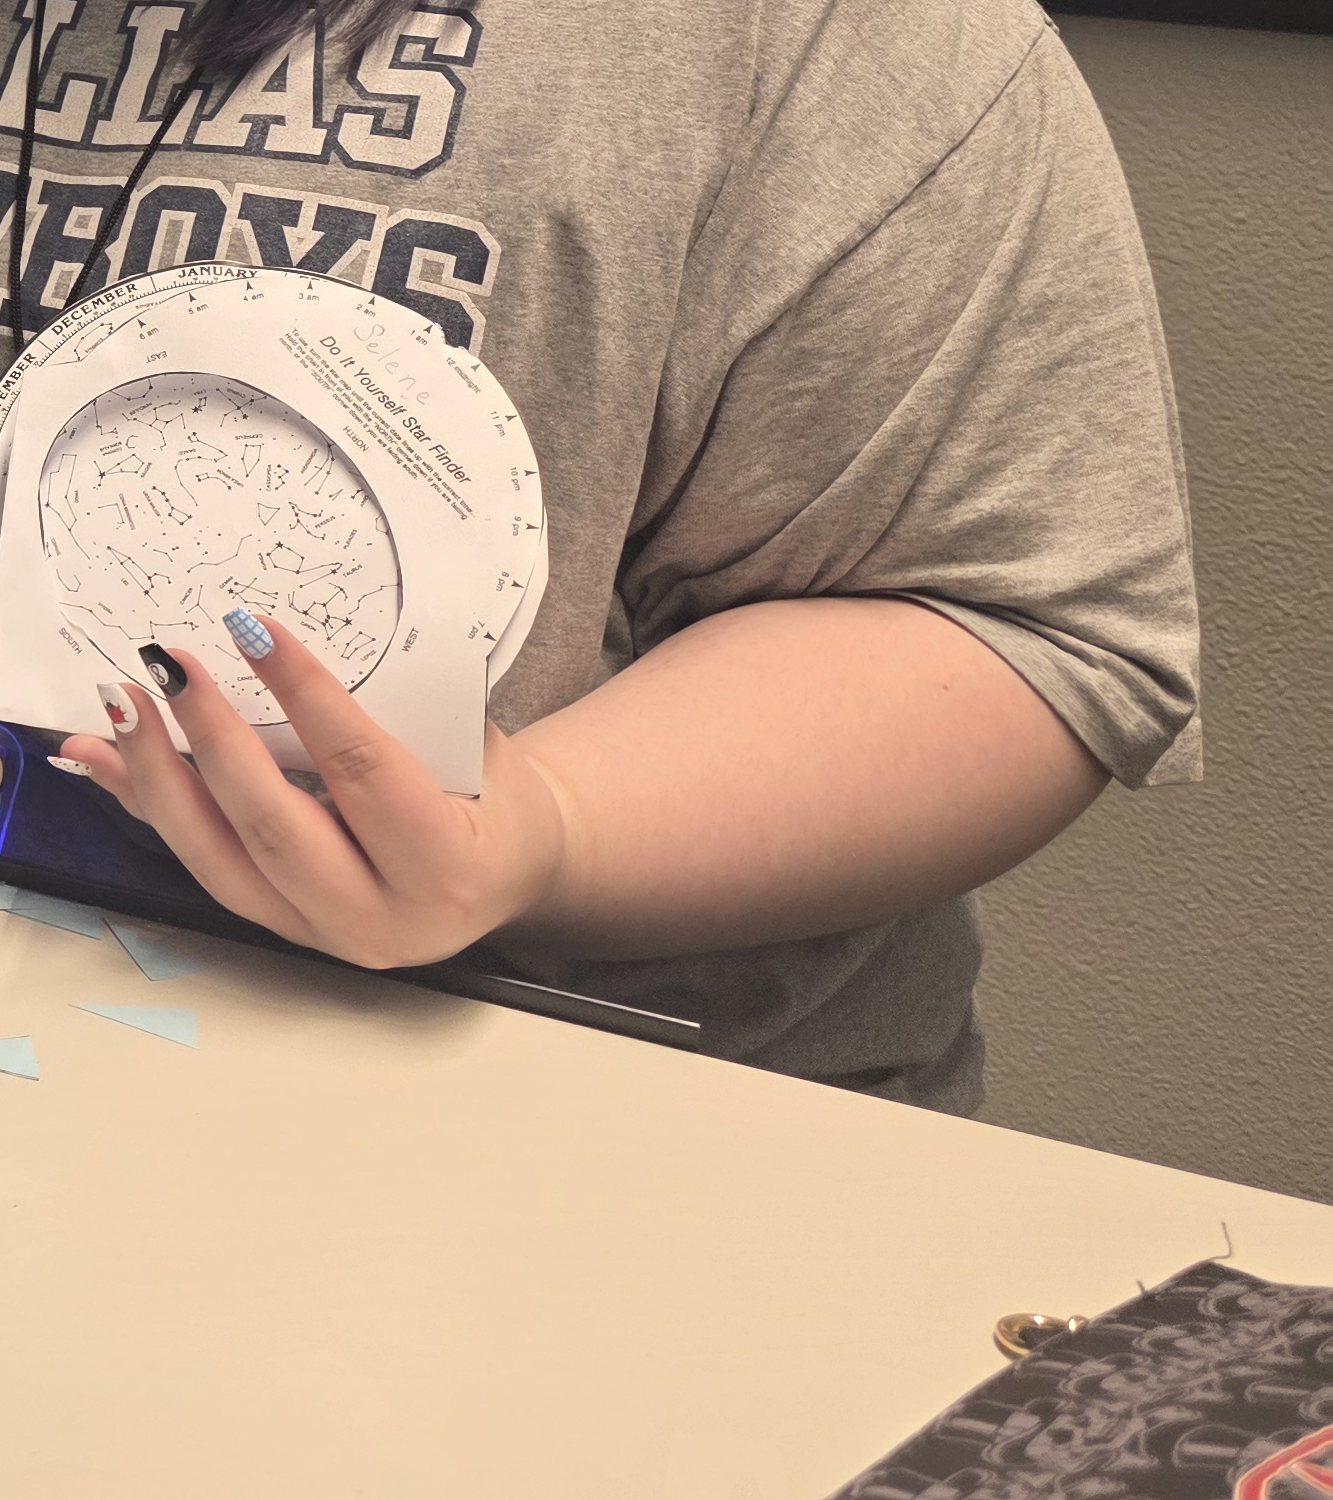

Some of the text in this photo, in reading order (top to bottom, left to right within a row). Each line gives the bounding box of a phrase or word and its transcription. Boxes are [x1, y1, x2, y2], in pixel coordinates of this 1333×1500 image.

[177, 264, 260, 280] JANUARY
[49, 282, 140, 337] DECEMBER
[146, 350, 168, 364] EAST
[353, 324, 431, 408] Selene
[319, 335, 471, 482] Do It Yourself Star Finder
[320, 359, 330, 369] the
[362, 401, 372, 411] the
[389, 428, 402, 440] date
[413, 453, 422, 461] up
[421, 461, 433, 472] with
[432, 471, 442, 481] the
[296, 345, 306, 355] the
[340, 392, 353, 403] you
[352, 402, 363, 412] with
[362, 412, 372, 422] the
[430, 482, 442, 493] you
[441, 492, 451, 502] are
[365, 428, 377, 438] you
[377, 438, 387, 447] are
[342, 425, 369, 452] NORTH
[342, 563, 363, 577] TAURUS
[57, 626, 83, 656] SOUTH
[401, 626, 420, 654] WEST
